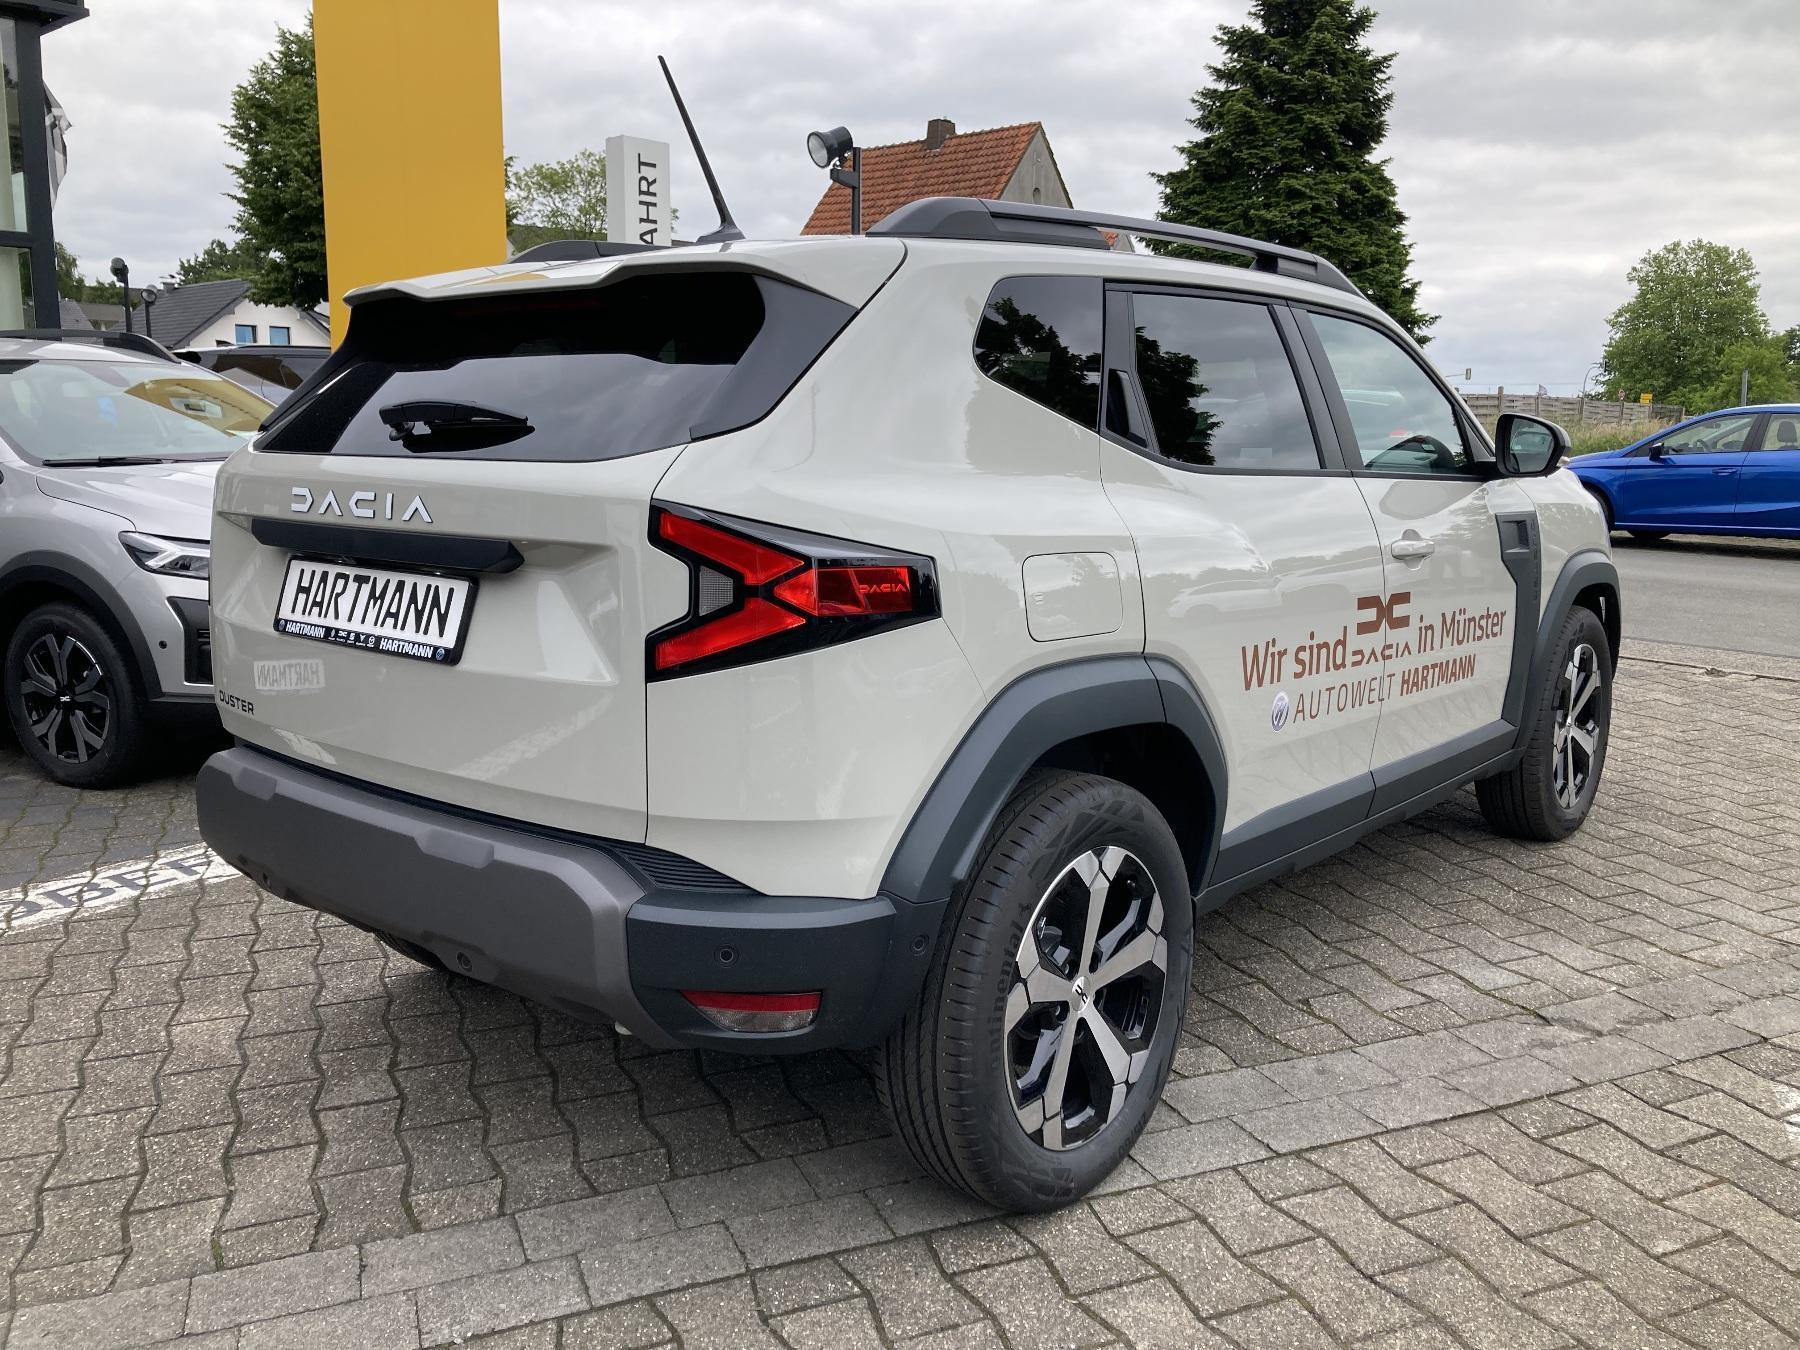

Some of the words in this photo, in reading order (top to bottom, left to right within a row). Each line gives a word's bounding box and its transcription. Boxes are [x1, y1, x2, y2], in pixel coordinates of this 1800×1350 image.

[291, 486, 433, 523] DACIA
[291, 567, 455, 638] HARTMANN
[859, 583, 907, 594] DACIA
[285, 621, 325, 639] HARTMANN
[379, 637, 433, 659] HARTMANN
[1241, 637, 1288, 692] Wir
[1293, 626, 1348, 680] sind
[1351, 640, 1412, 668] DACIA
[1417, 614, 1435, 654] in
[1440, 606, 1507, 649] Münster
[219, 690, 255, 716] DUSTER
[1293, 672, 1396, 724] AUTOWELT
[1400, 654, 1477, 697] HARTMANN
